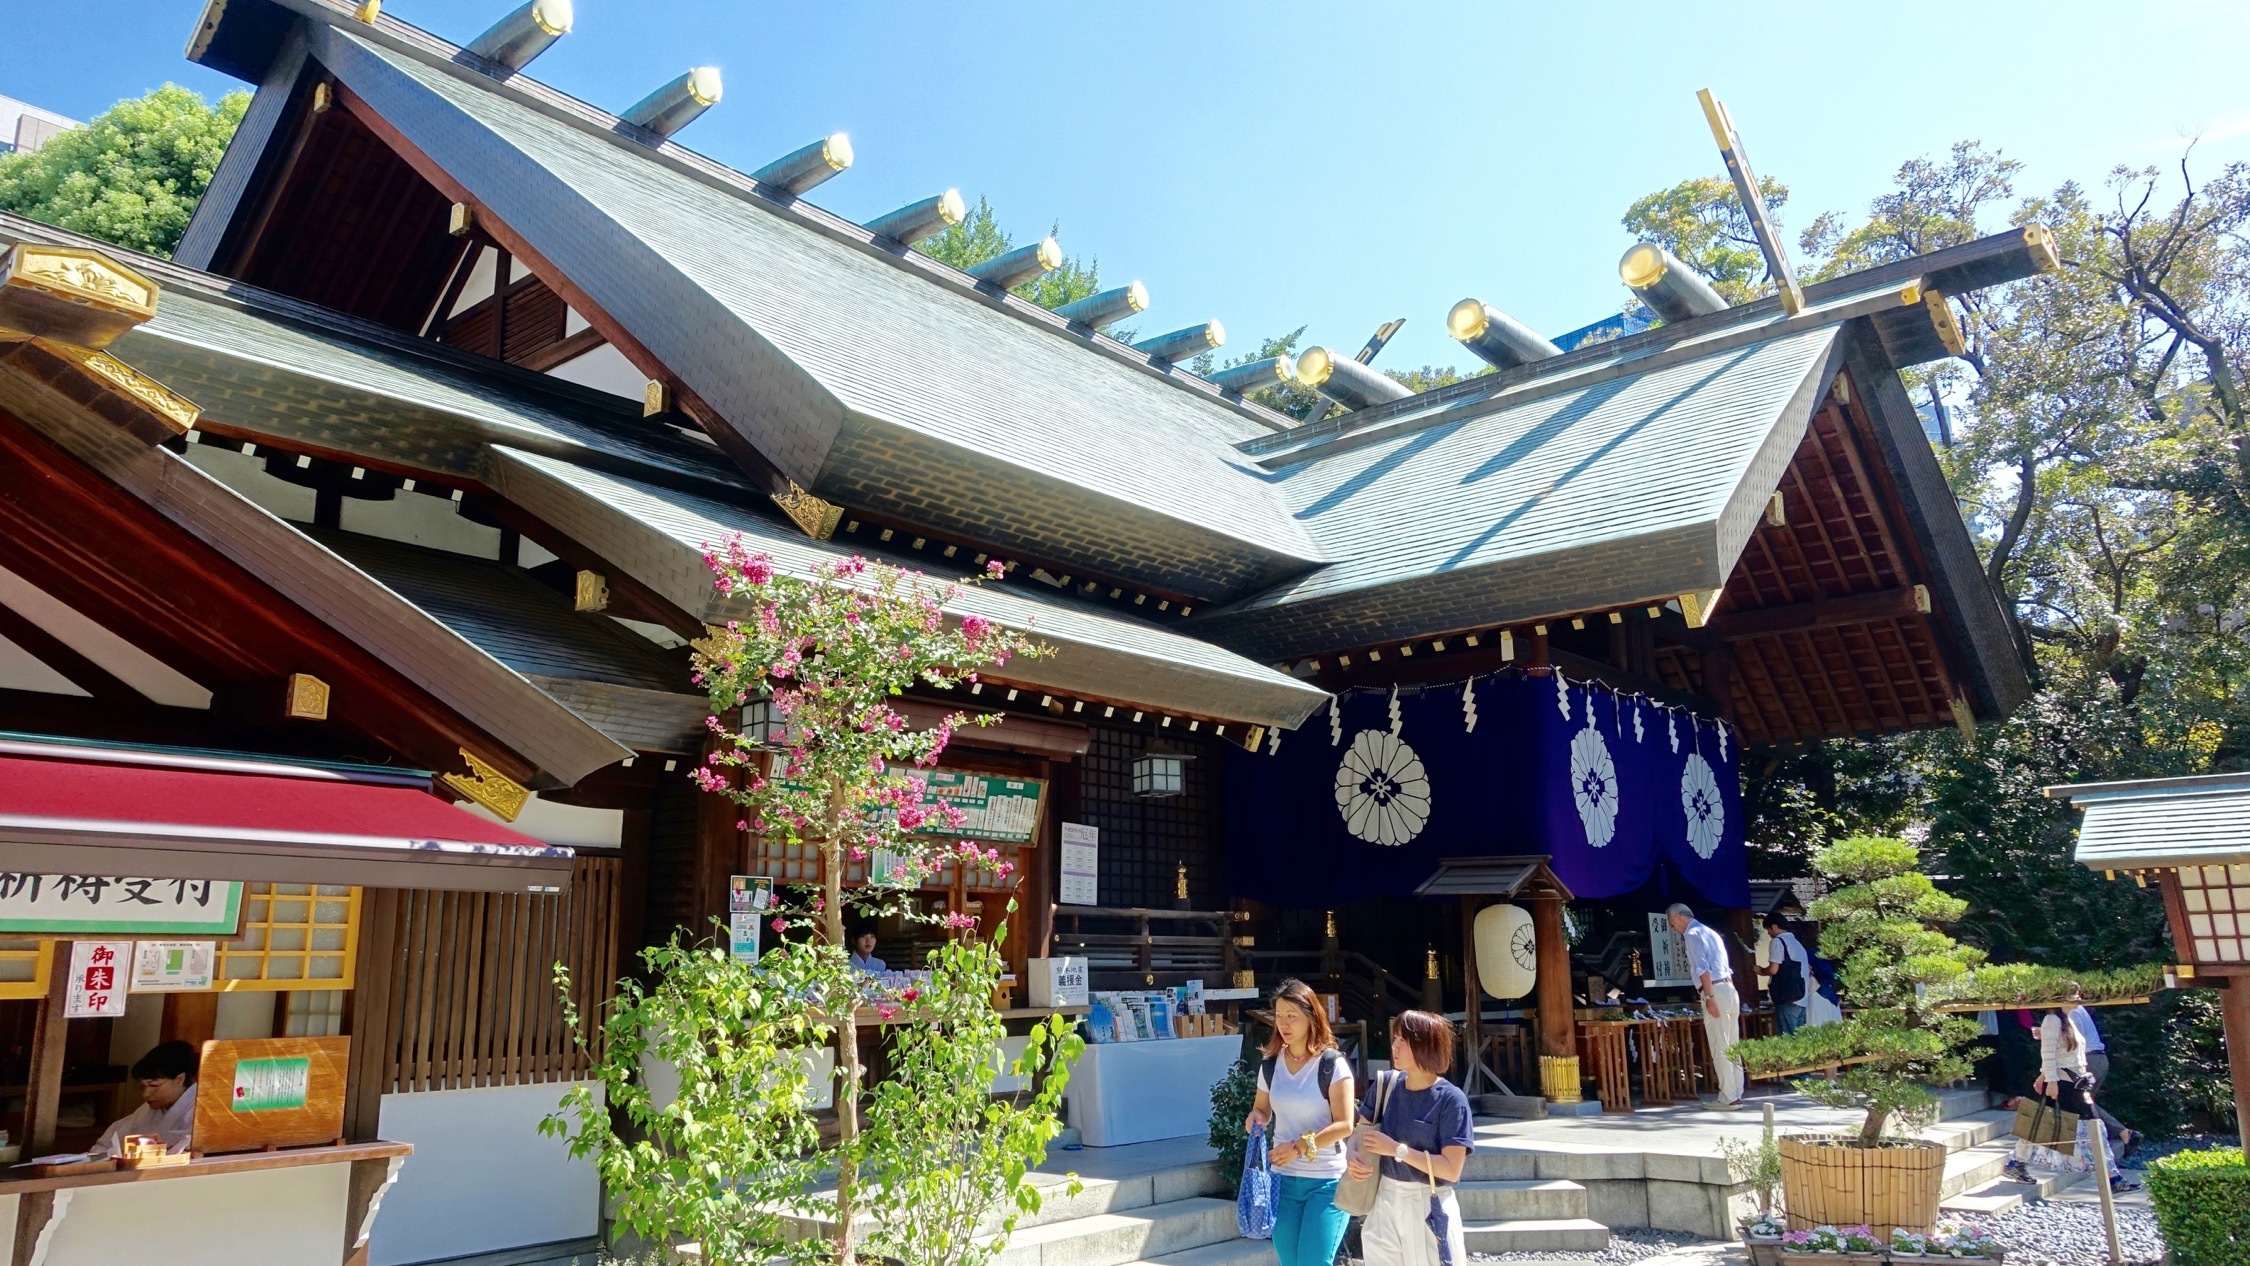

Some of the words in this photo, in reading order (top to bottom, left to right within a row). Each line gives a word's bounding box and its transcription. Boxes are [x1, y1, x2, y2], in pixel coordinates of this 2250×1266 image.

[1652, 917, 1663, 977] 受付
[72, 974, 85, 1013] 承ります
[88, 945, 115, 1012] 御朱印
[1058, 974, 1083, 987] 義援金
